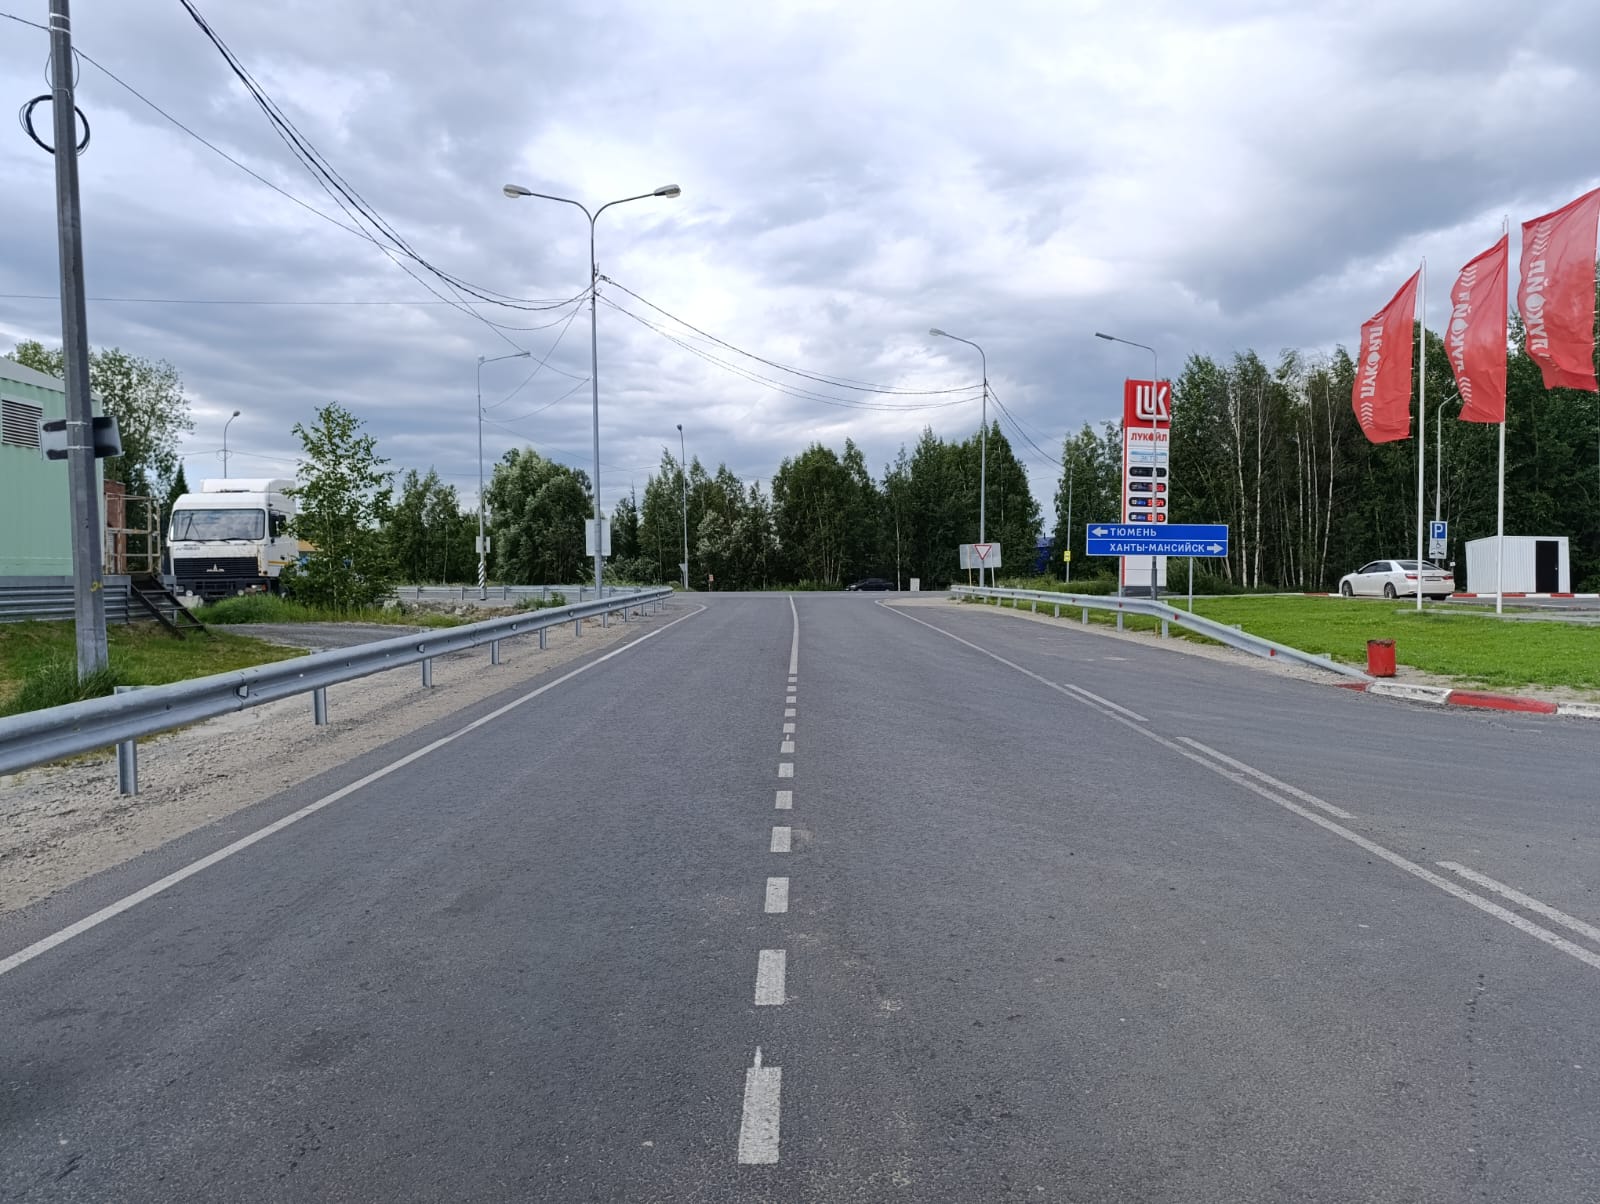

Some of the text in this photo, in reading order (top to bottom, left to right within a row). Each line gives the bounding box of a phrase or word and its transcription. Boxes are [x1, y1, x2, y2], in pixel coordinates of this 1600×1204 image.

[1130, 431, 1168, 442] ЛУКОЙЛ
[1110, 527, 1157, 537] ТЮМЕНЬ
[1434, 523, 1443, 538] P
[1110, 541, 1205, 553] ХАНТЫ-МАНСИЙСК
